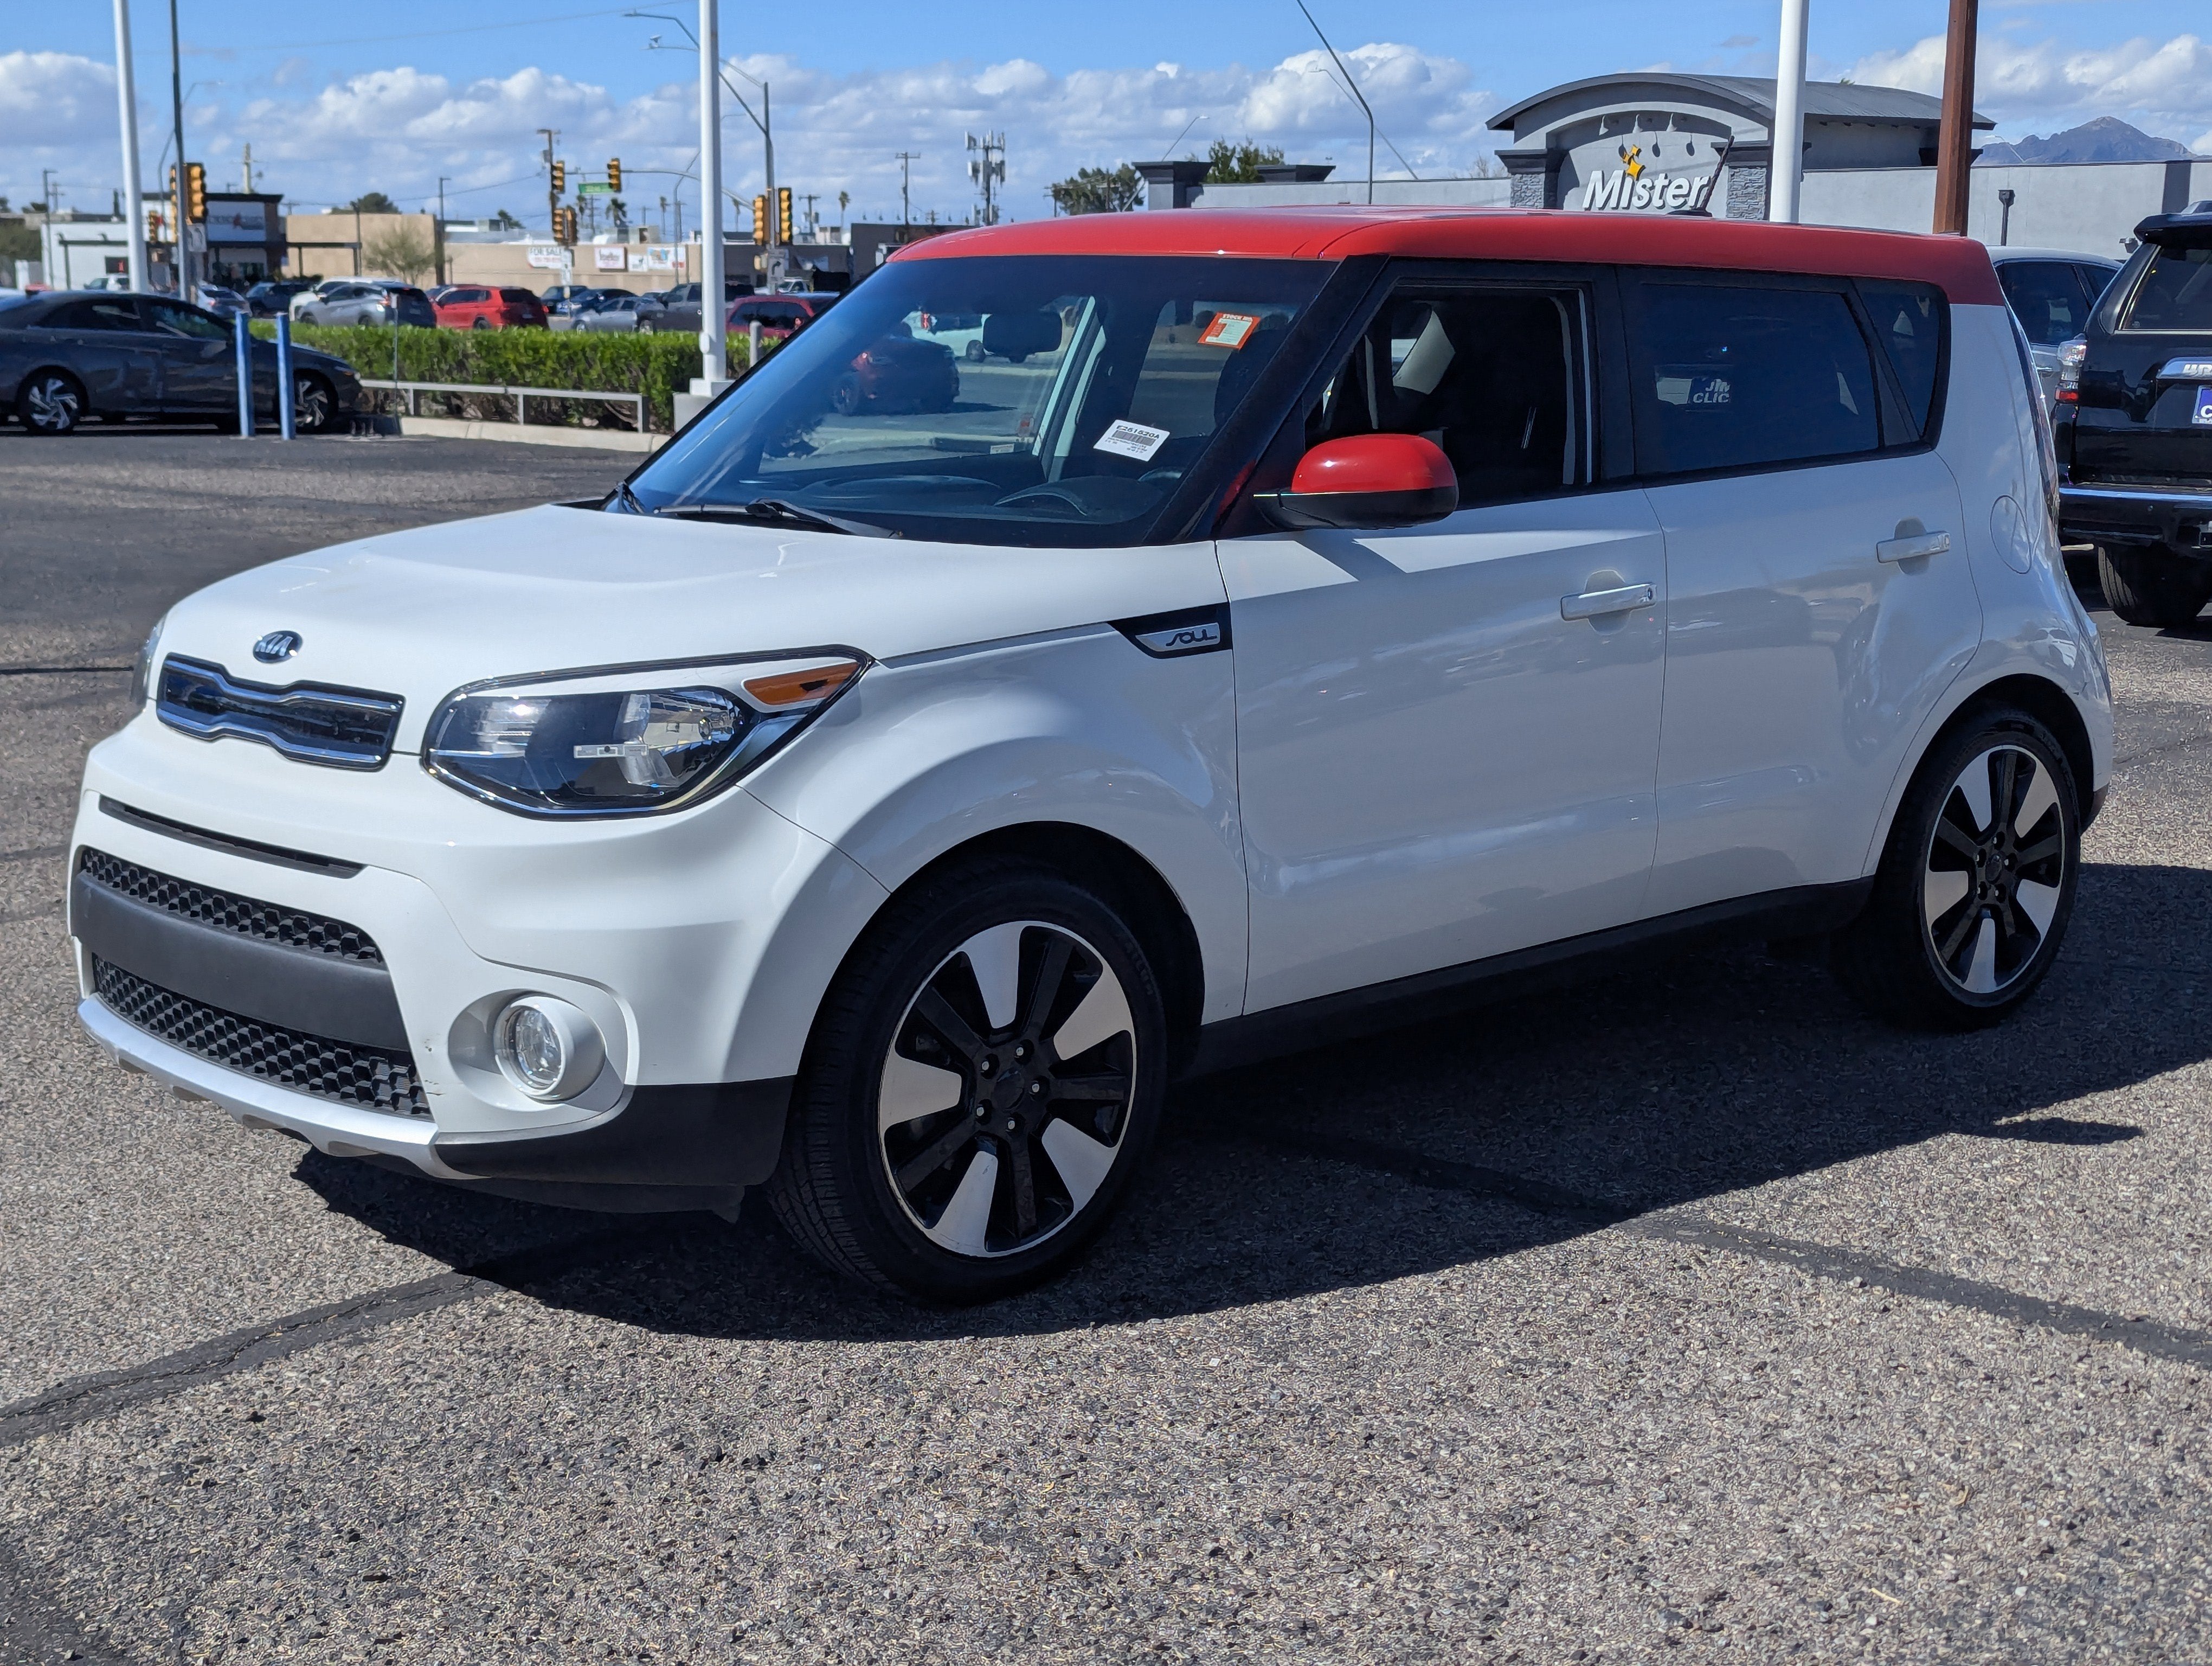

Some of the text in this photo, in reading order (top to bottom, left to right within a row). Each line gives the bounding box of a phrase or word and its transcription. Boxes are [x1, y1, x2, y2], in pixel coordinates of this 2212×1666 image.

[1582, 169, 1711, 210] Mister
[2200, 405, 2212, 418] C
[255, 634, 294, 657] KIA
